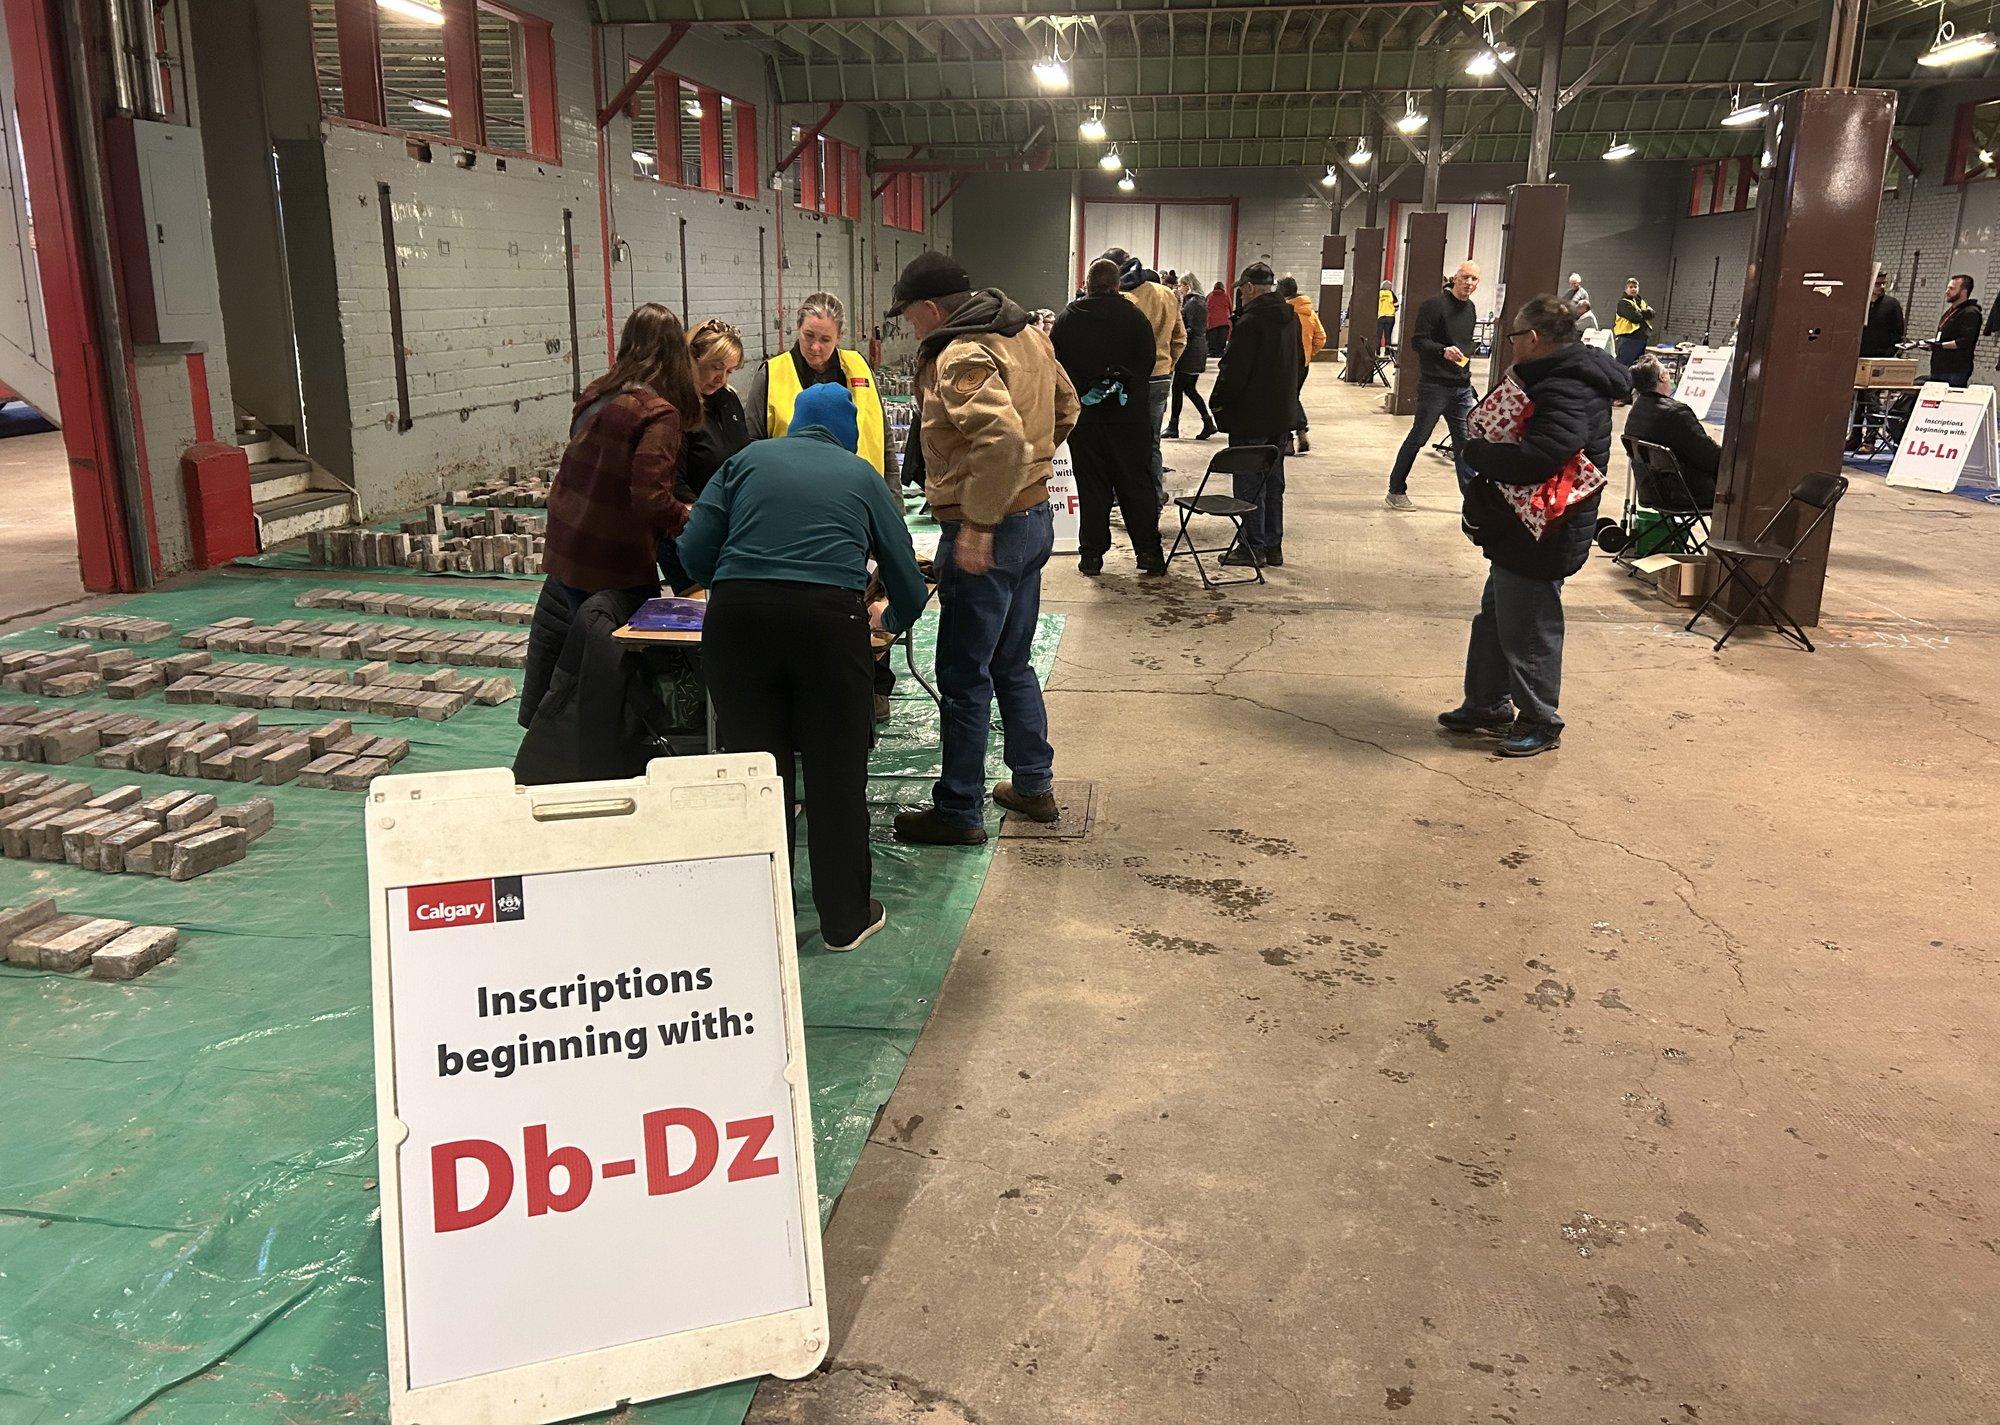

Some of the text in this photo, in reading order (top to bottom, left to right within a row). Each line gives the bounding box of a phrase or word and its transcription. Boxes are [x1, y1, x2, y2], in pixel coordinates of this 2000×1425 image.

[1684, 386, 1706, 397] L-La
[1915, 425, 1949, 436] beginning
[1924, 418, 1964, 427] Inscriptions
[1906, 440, 1958, 460] Lb-Ln
[416, 901, 487, 924] Calgary
[478, 967, 713, 1019] Inscriptions
[438, 1007, 754, 1078] beginning with:
[431, 1107, 780, 1233] Db-Dz
